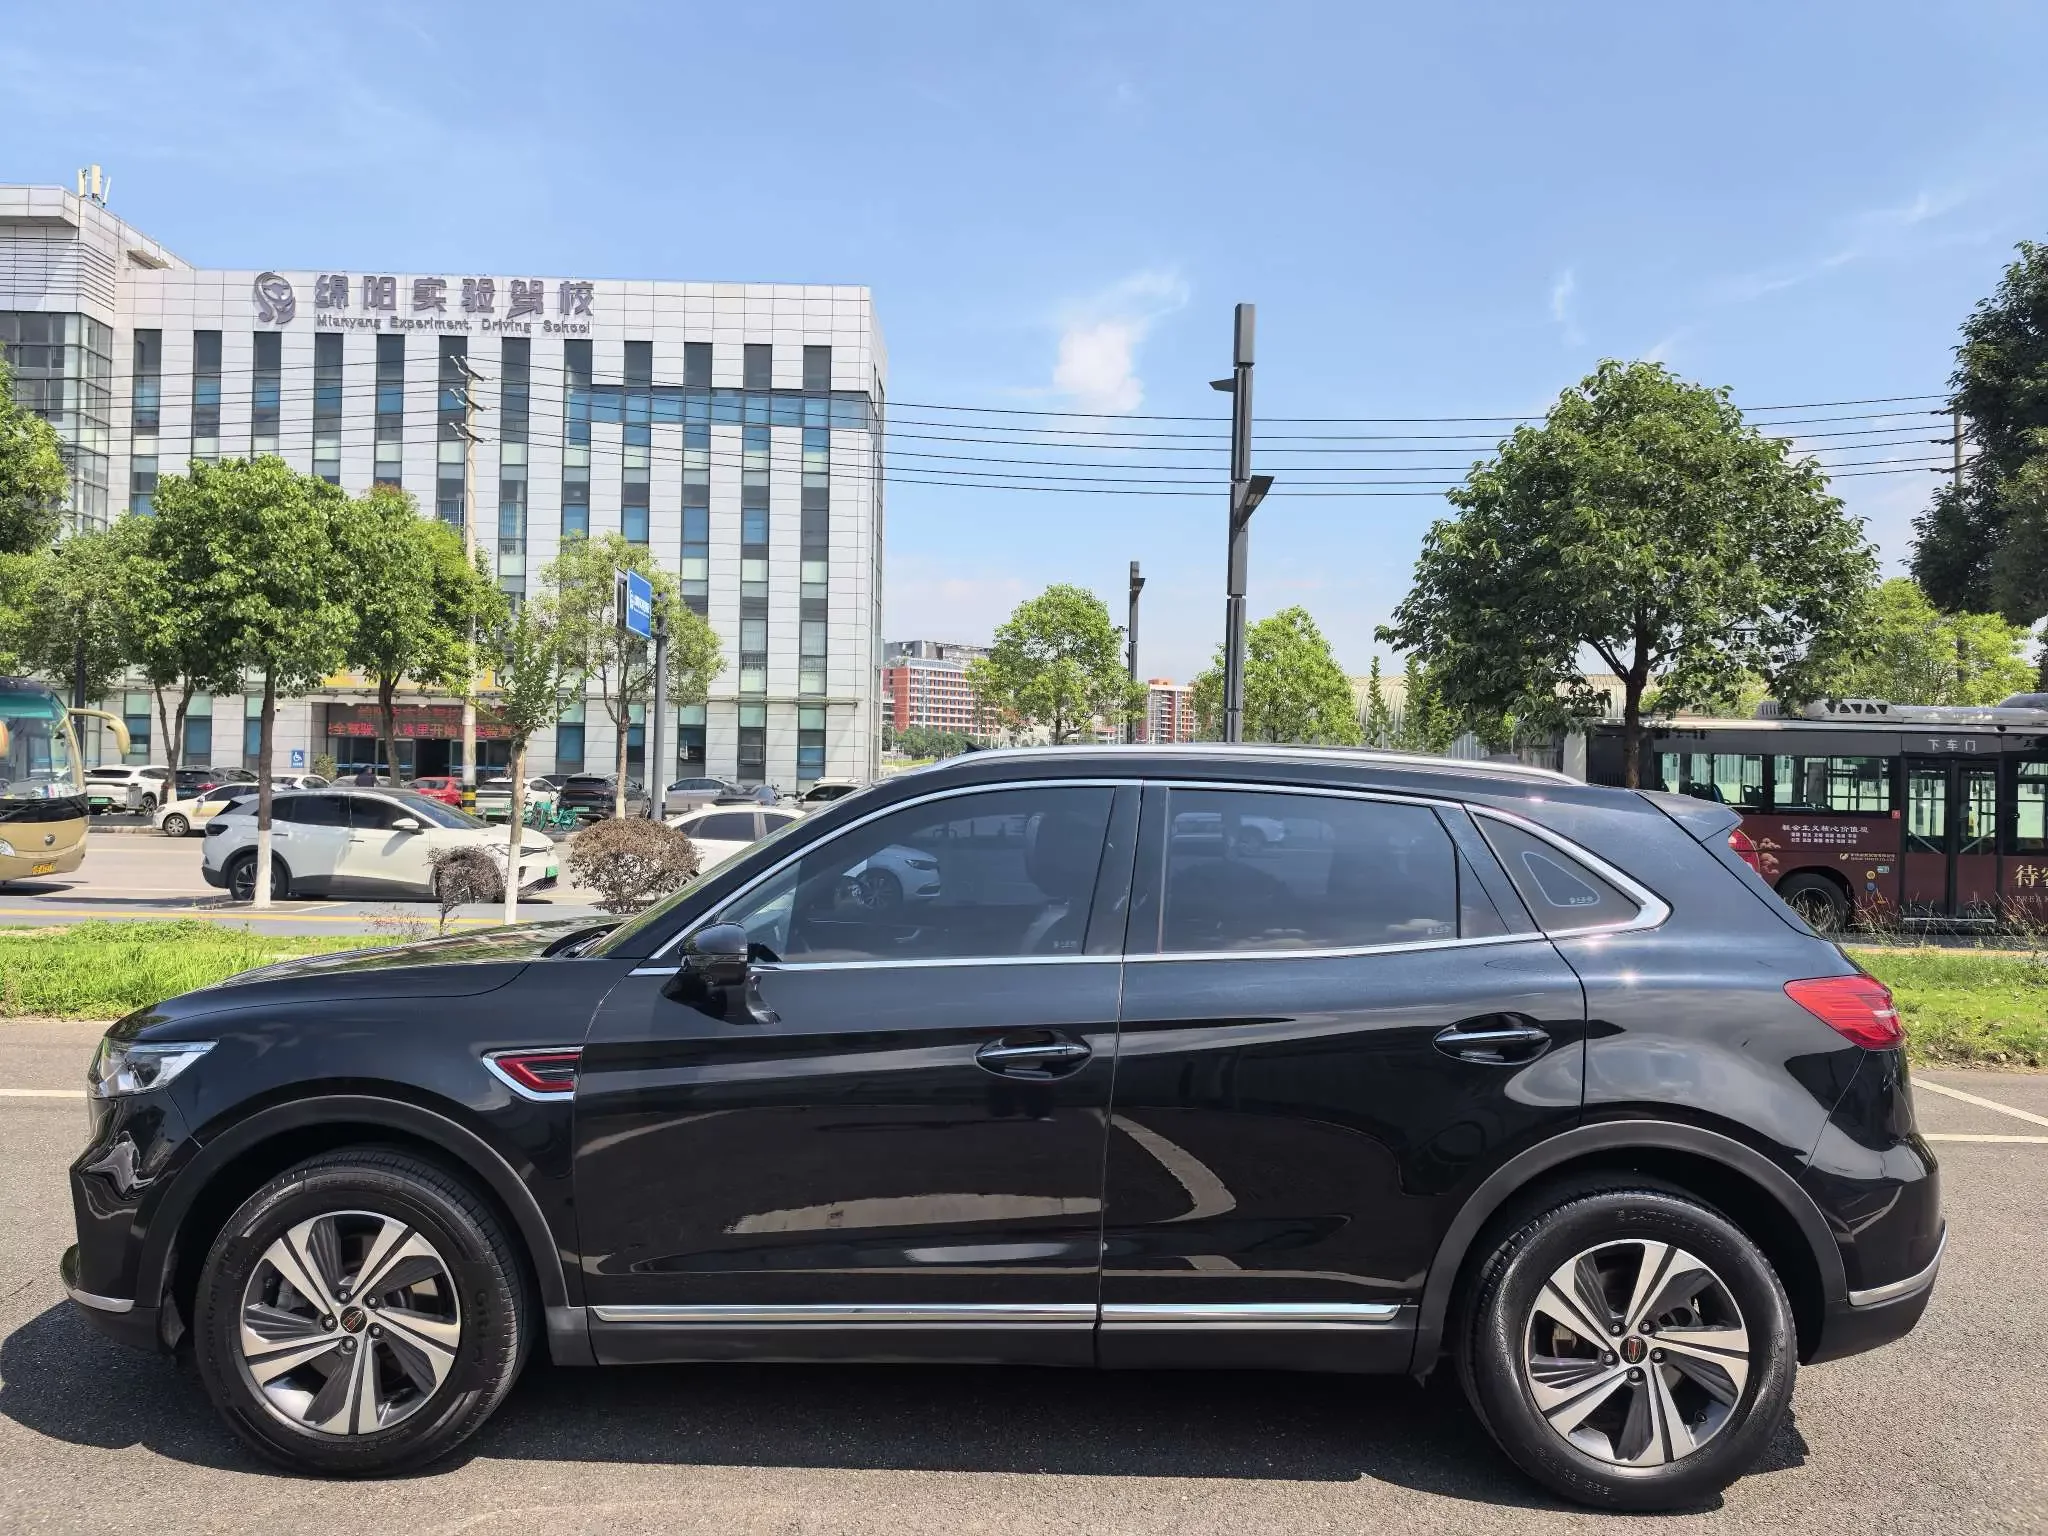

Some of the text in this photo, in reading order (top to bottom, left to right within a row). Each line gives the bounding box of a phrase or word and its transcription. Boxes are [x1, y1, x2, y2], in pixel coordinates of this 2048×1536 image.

[315, 275, 594, 319] 绵阳实验驾校
[317, 314, 382, 330] Mianyang
[481, 318, 532, 334] Driving
[543, 320, 590, 334] School
[1928, 739, 1976, 751] 下车门
